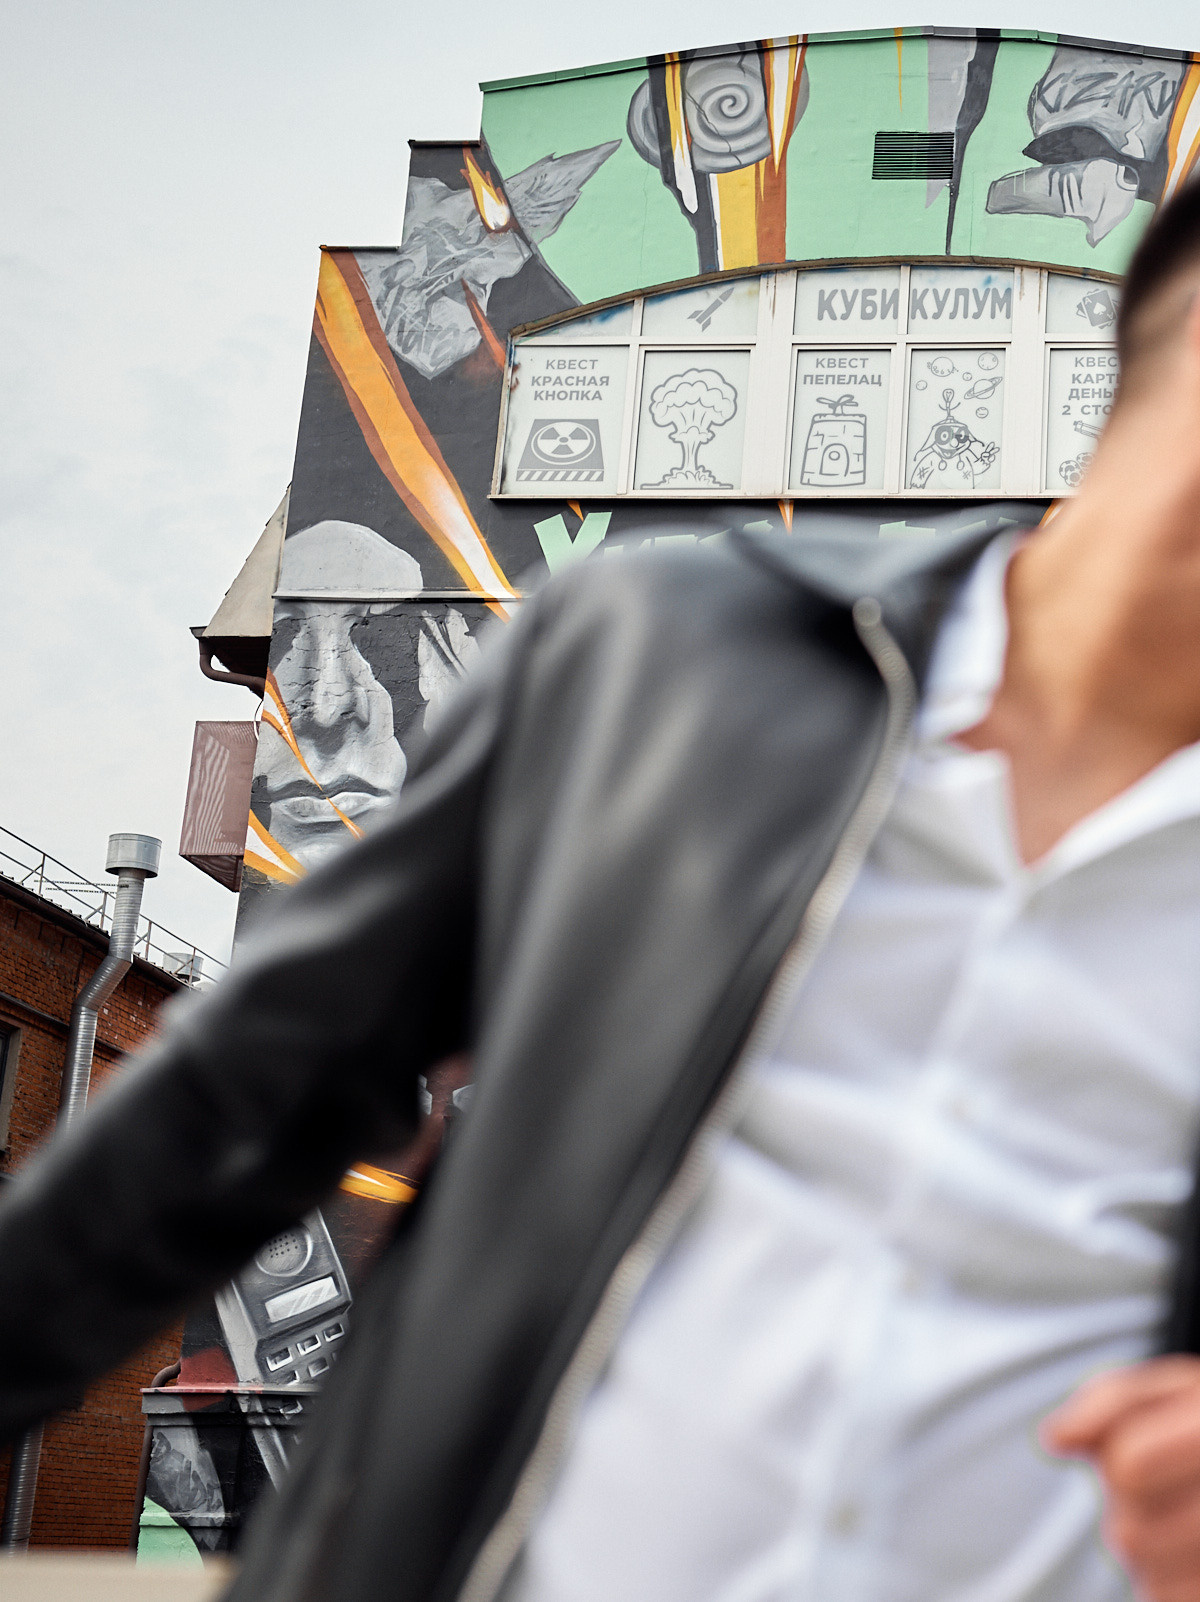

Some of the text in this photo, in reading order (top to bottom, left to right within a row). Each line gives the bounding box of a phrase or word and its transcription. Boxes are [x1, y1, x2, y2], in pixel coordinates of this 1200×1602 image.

[545, 359, 599, 370] КВЕСТ
[815, 357, 869, 369] КВЕСТ
[1074, 356, 1118, 368] КВЕС
[530, 375, 610, 387] КРАСНАЯ
[803, 374, 882, 387] ПЕПЕЛАЦ
[533, 390, 603, 401] КНОПКА
[1068, 388, 1118, 401] ДЕНЬ
[1061, 404, 1072, 416] 2
